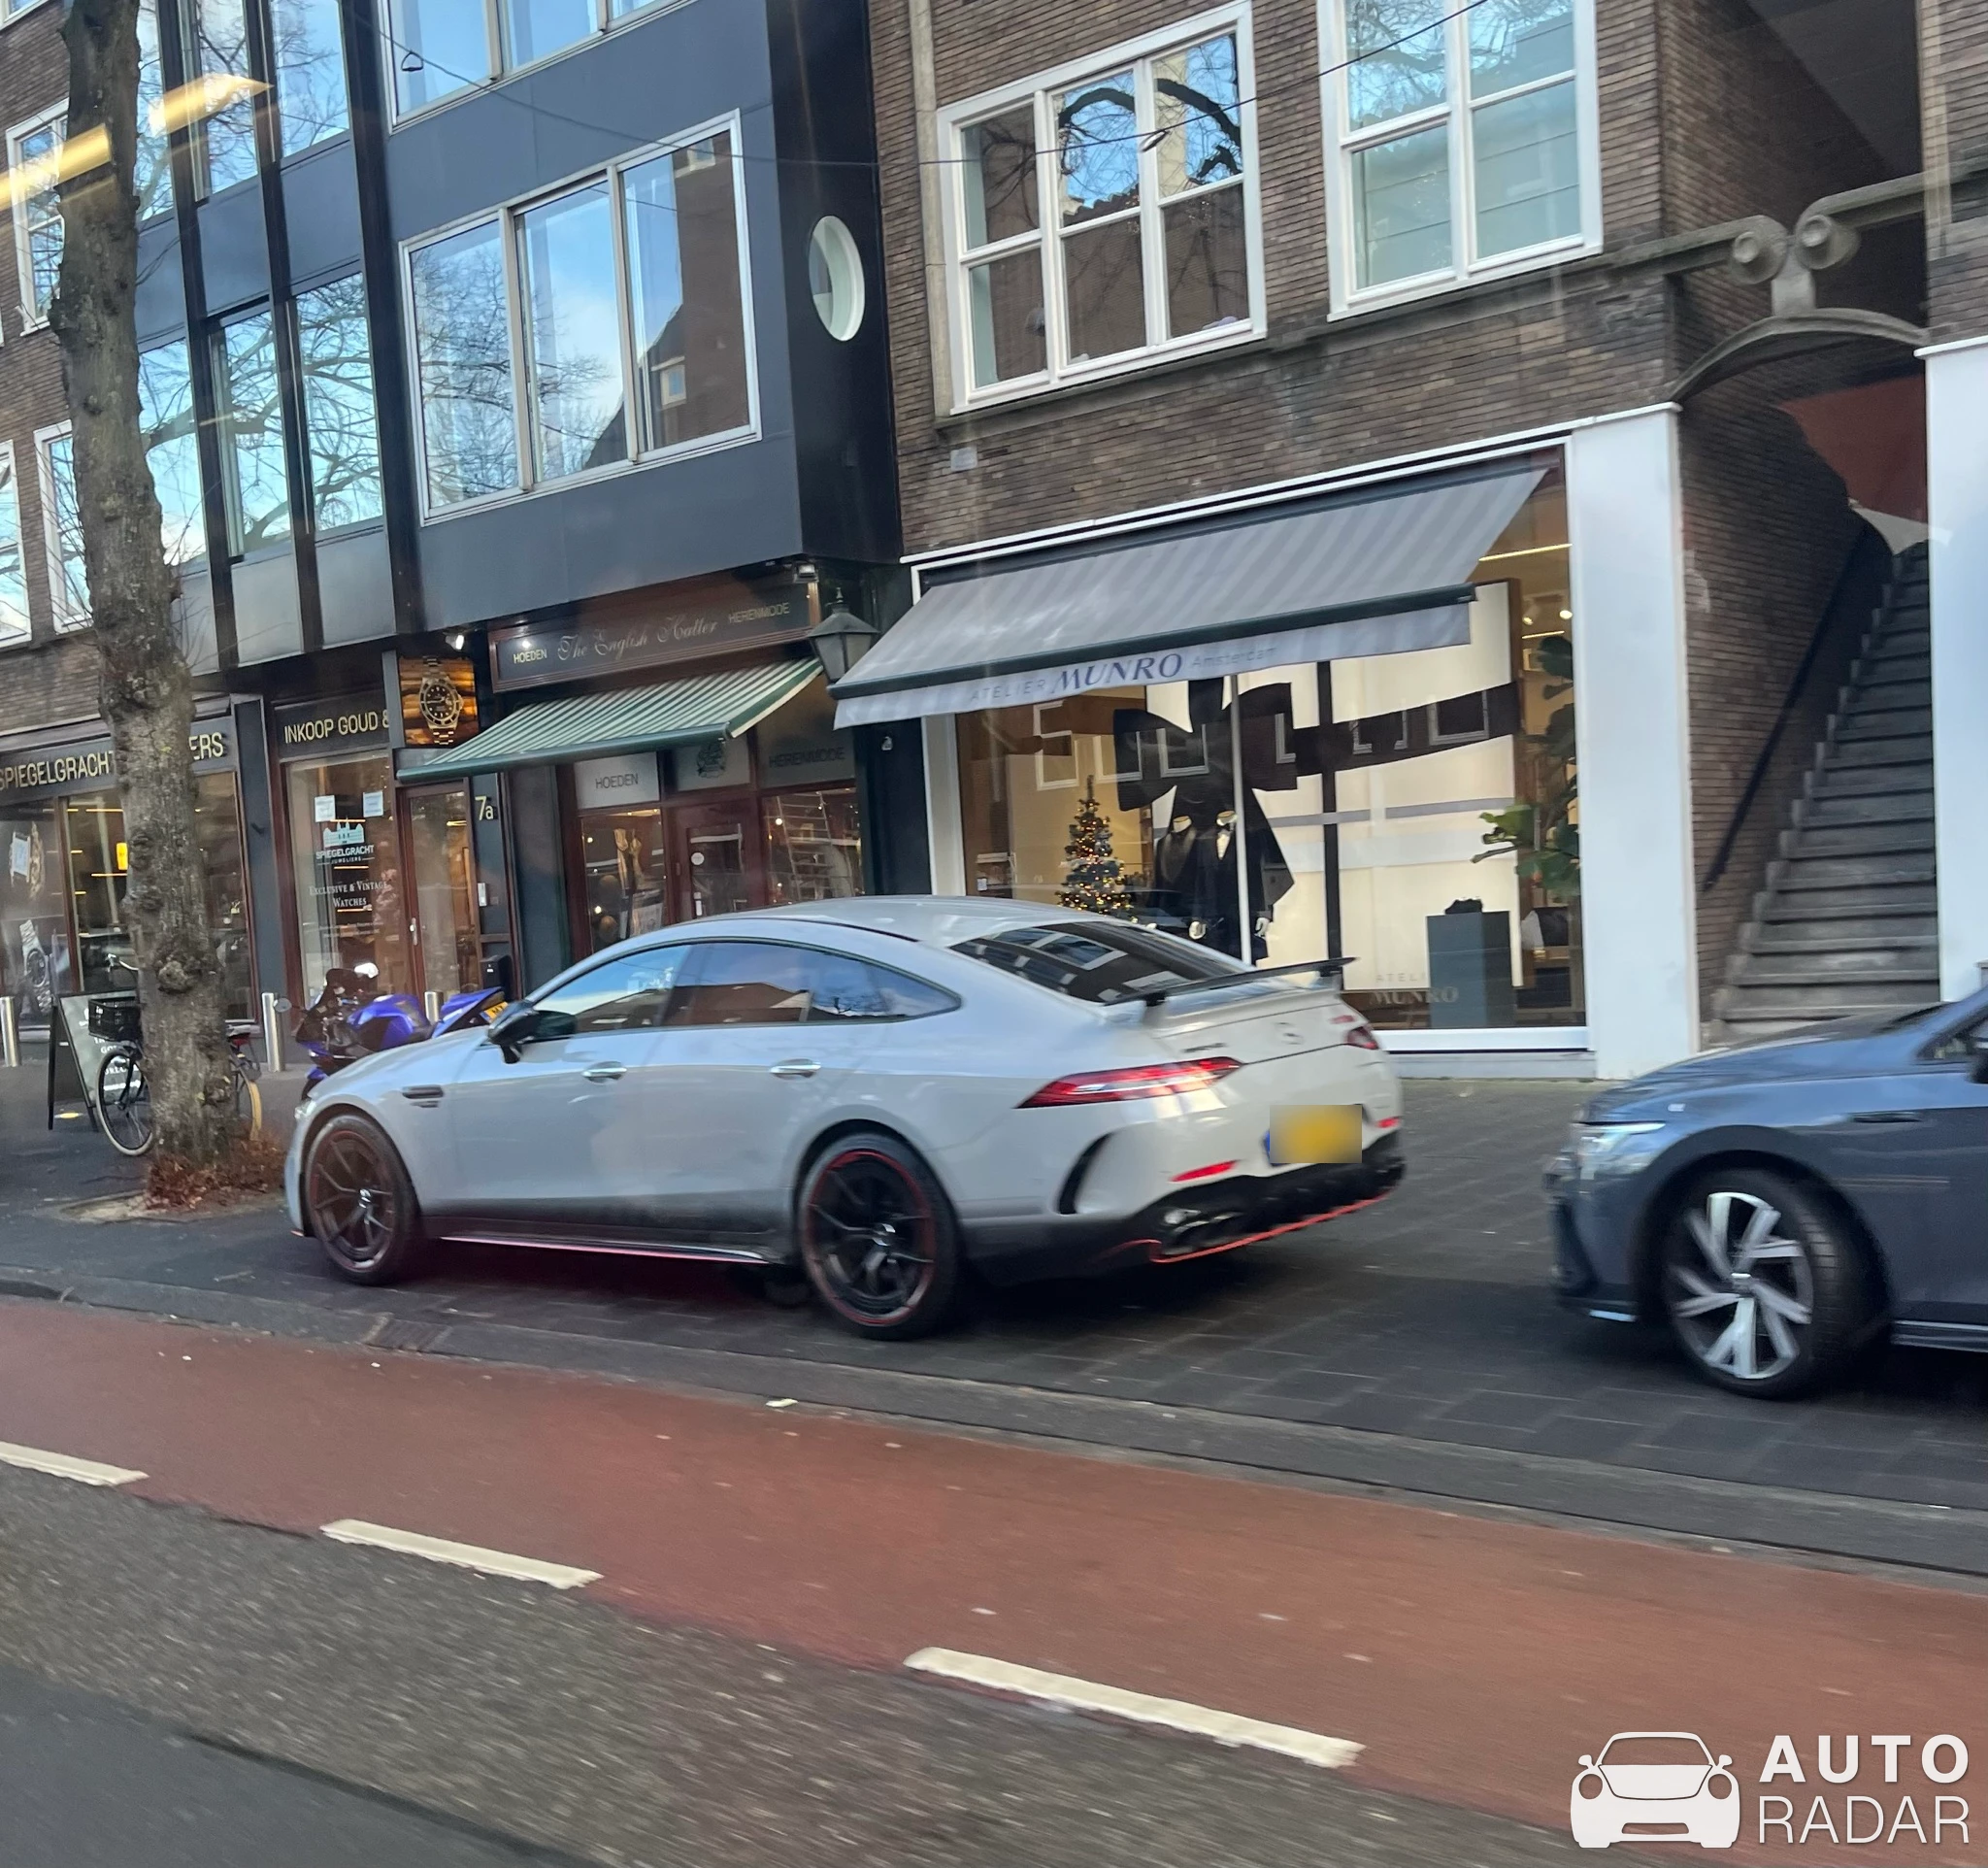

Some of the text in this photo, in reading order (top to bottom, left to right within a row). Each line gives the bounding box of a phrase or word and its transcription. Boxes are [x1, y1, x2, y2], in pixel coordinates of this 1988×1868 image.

[513, 649, 547, 664] HOEDEN
[557, 634, 588, 660] The
[593, 628, 647, 660] English
[728, 602, 790, 624] HERENMODE
[971, 679, 1045, 701] ATELIER
[1050, 652, 1183, 694] MUNRO
[284, 718, 334, 744] INKOOP
[338, 711, 379, 736] GOUD
[595, 773, 639, 789] HOEDEN
[476, 796, 494, 820] 7a
[315, 845, 375, 860] SPIEGELGRACHT
[1370, 986, 1459, 1005] MUNRO
